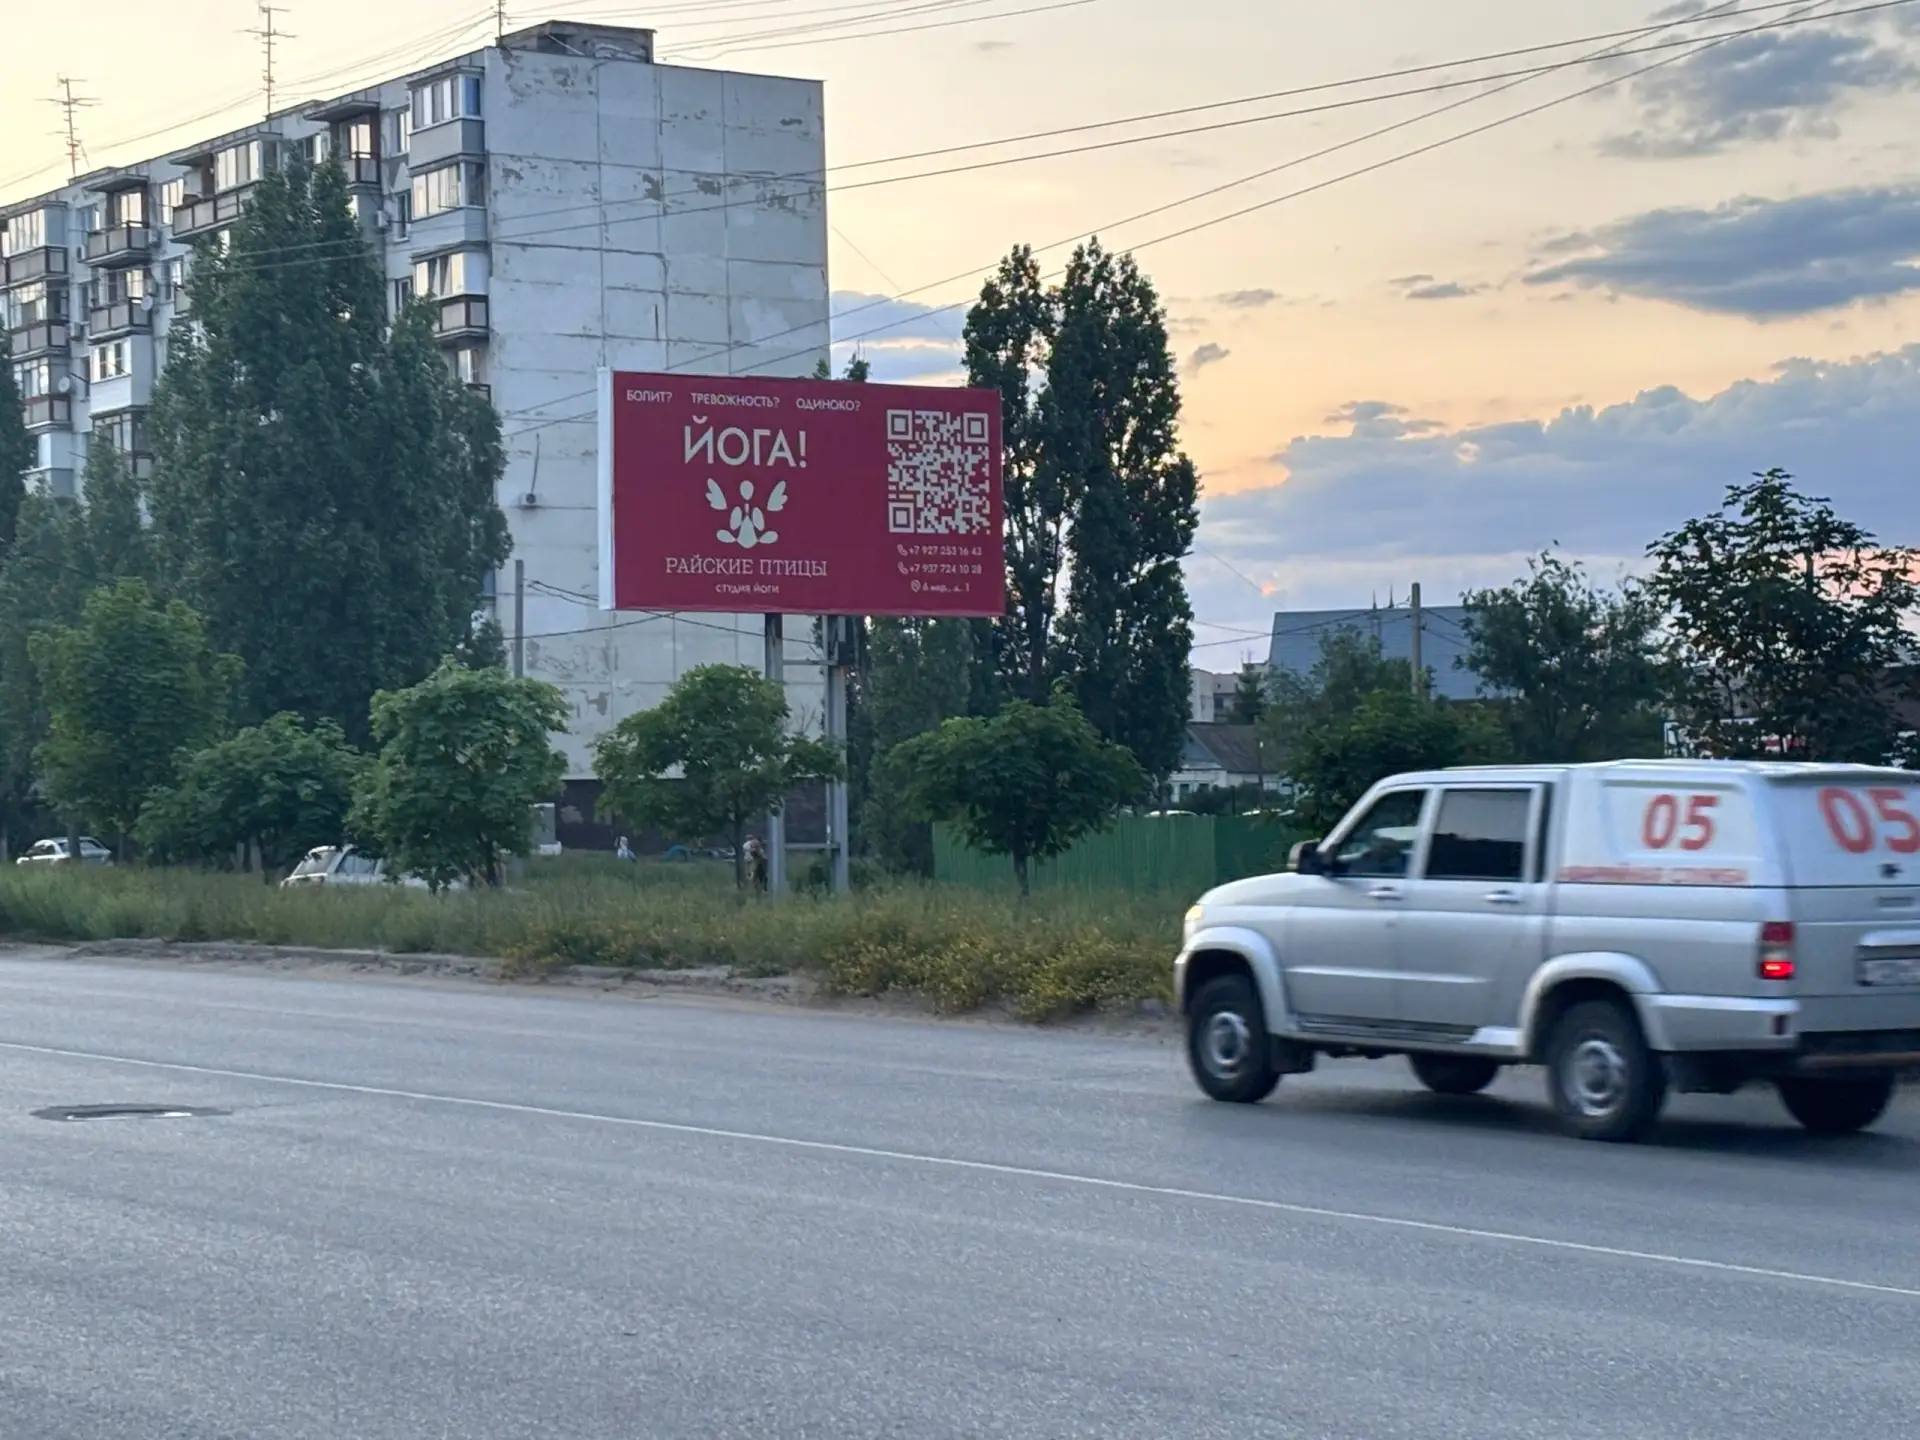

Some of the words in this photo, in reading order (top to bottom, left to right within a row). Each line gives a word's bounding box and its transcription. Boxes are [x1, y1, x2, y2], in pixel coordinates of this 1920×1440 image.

[626, 389, 673, 403] БОЛИТ?
[690, 392, 781, 409] ТРЕВОЖНОСТЬ?
[796, 397, 861, 412] ОДИНОКО?
[683, 414, 808, 469] ЙОГА!
[665, 554, 754, 576] РАЙСКИЕ
[759, 558, 828, 578] ПТИЦЫ
[1642, 795, 1721, 851] 05
[1817, 787, 1920, 853] 05
